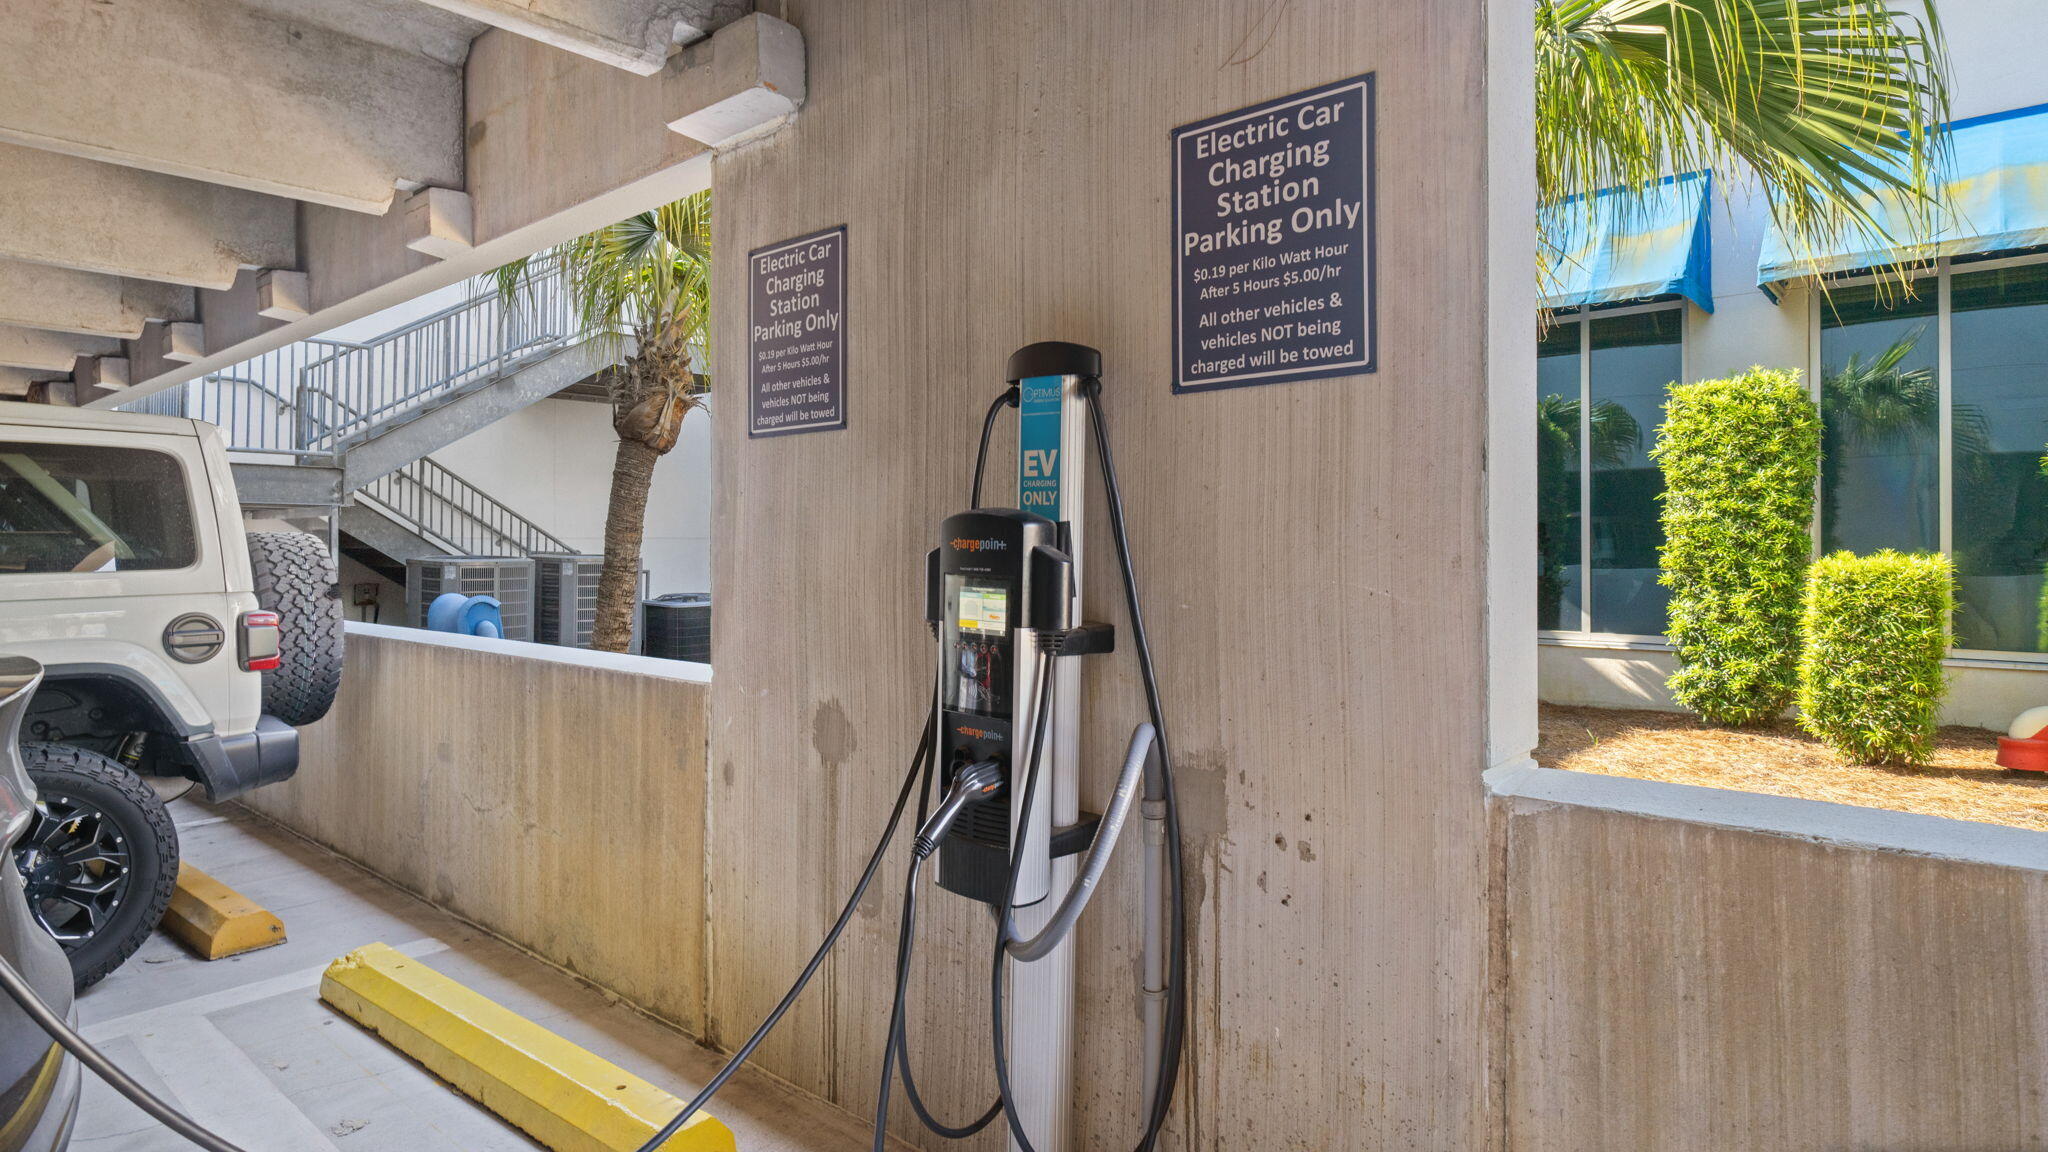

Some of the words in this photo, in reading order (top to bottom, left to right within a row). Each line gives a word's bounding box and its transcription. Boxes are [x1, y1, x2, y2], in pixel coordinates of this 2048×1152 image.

[1197, 115, 1289, 159] Electric
[1298, 100, 1344, 130] Car
[1208, 138, 1330, 187] Charging
[1217, 176, 1319, 218] Station
[1184, 216, 1282, 257] Parking
[1292, 199, 1360, 233] Only
[760, 252, 805, 274] Electric
[809, 242, 831, 260] Car
[1193, 265, 1225, 283] $0.19
[1229, 264, 1249, 277] per
[1253, 257, 1276, 271] Kilo
[1280, 250, 1311, 267] Watt
[1315, 241, 1348, 261] Hour
[766, 269, 824, 295] Charging
[1200, 283, 1229, 300] After
[1233, 283, 1240, 295] 5
[1244, 275, 1280, 293] Hours
[1283, 265, 1341, 286] $5.00/hr
[770, 293, 819, 317] Station
[1199, 312, 1216, 328] All
[1221, 306, 1259, 325] other
[1264, 298, 1324, 319] vehicles
[1330, 292, 1342, 308] &
[754, 320, 801, 342] Parking
[806, 310, 839, 331] Only
[1201, 329, 1256, 351] vehicles
[1261, 324, 1293, 342] NOT
[1297, 318, 1341, 337] being
[759, 350, 775, 361] $0.19
[776, 350, 785, 358] per
[787, 346, 799, 355] Kilo
[800, 343, 815, 352] Watt
[817, 340, 833, 349] Hour
[762, 363, 776, 373] After
[778, 363, 782, 371] 5
[783, 360, 800, 370] Hours
[802, 355, 829, 367] $5.00/hr
[1191, 354, 1245, 375] charged
[1250, 350, 1275, 368] will
[1280, 346, 1298, 364] be
[1303, 340, 1353, 361] towed
[761, 382, 770, 393] All
[772, 380, 790, 391] other
[792, 376, 821, 389] vehicles
[824, 373, 830, 384] &
[762, 397, 789, 408] vehicles
[791, 395, 806, 405] NOT
[809, 392, 829, 404] being
[757, 413, 783, 426] charged
[785, 411, 798, 422] will
[800, 410, 809, 420] be
[811, 407, 835, 419] towed
[1024, 449, 1058, 477] EV
[1024, 491, 1057, 506] ONLY
